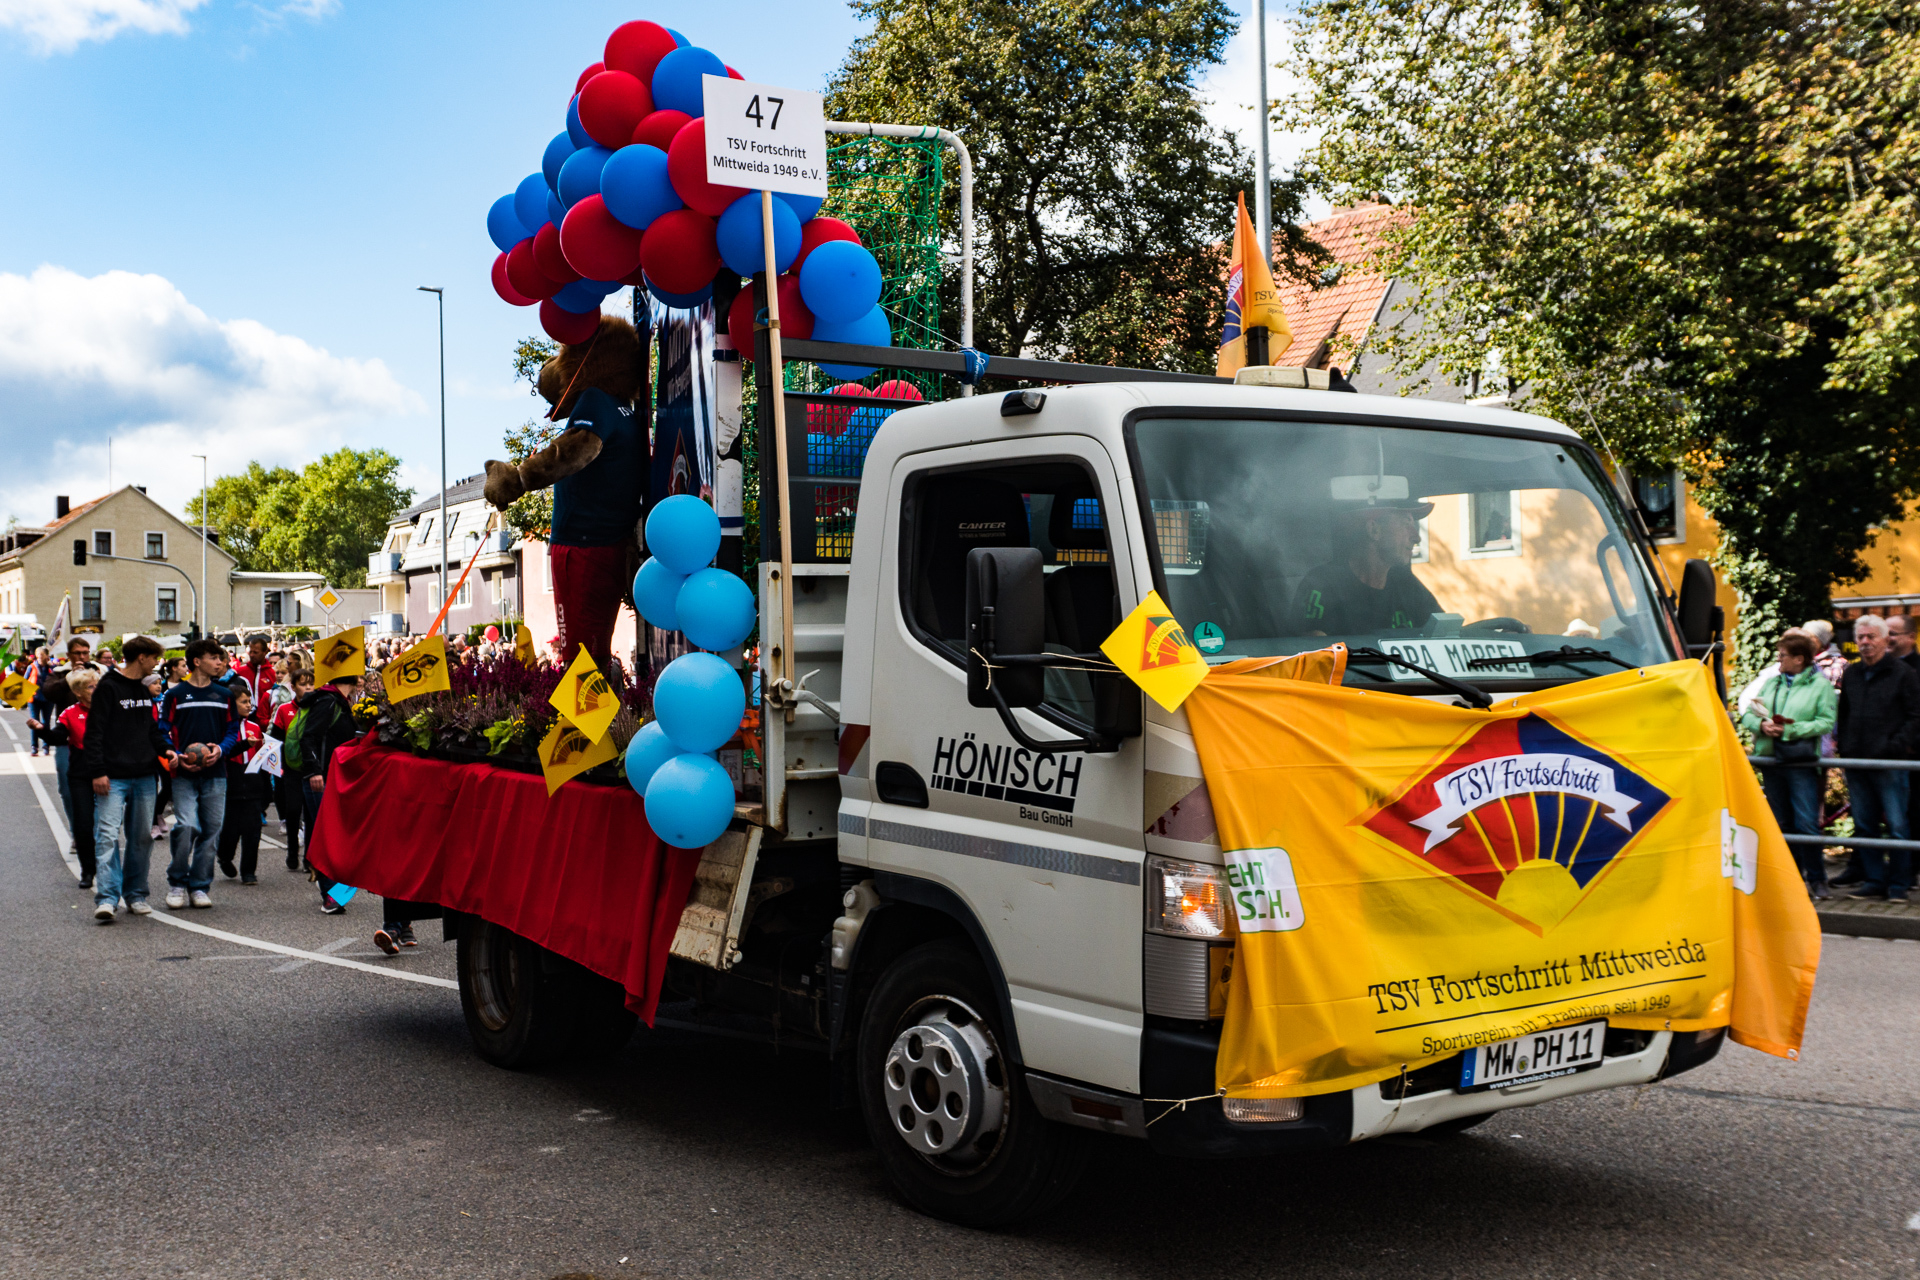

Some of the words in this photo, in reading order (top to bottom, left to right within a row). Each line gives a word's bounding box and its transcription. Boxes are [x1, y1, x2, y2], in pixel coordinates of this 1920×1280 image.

[745, 94, 784, 130] 47
[727, 137, 748, 151] TSV
[751, 141, 806, 160] Fortschritt
[713, 156, 770, 174] Mittweida
[773, 164, 798, 177] 1949
[801, 168, 822, 180] e.V.
[1254, 290, 1276, 301] TSV
[958, 521, 1006, 530] CANTER
[1203, 622, 1214, 637] 4
[1390, 644, 1439, 675] OPA
[1444, 643, 1529, 674] MARCEL
[932, 731, 1084, 798] HÖNISCH
[1448, 761, 1497, 806] TSV
[1500, 757, 1600, 793] Fortschritt
[1019, 806, 1038, 822] Bau
[1040, 809, 1074, 828] GmbH
[1368, 979, 1421, 1014] TSV
[1430, 958, 1573, 1005] Fortschritt
[1578, 938, 1707, 982] Mittweida
[1422, 1026, 1511, 1056] Sportverein
[1614, 1000, 1638, 1016] seit
[1642, 994, 1672, 1011] 1949
[1484, 1042, 1517, 1078] MW
[1532, 1032, 1564, 1069] PH
[1566, 1028, 1594, 1062] 11
[1464, 1070, 1472, 1080] D
[1489, 1067, 1578, 1090] www.hoenisch-bau.de
